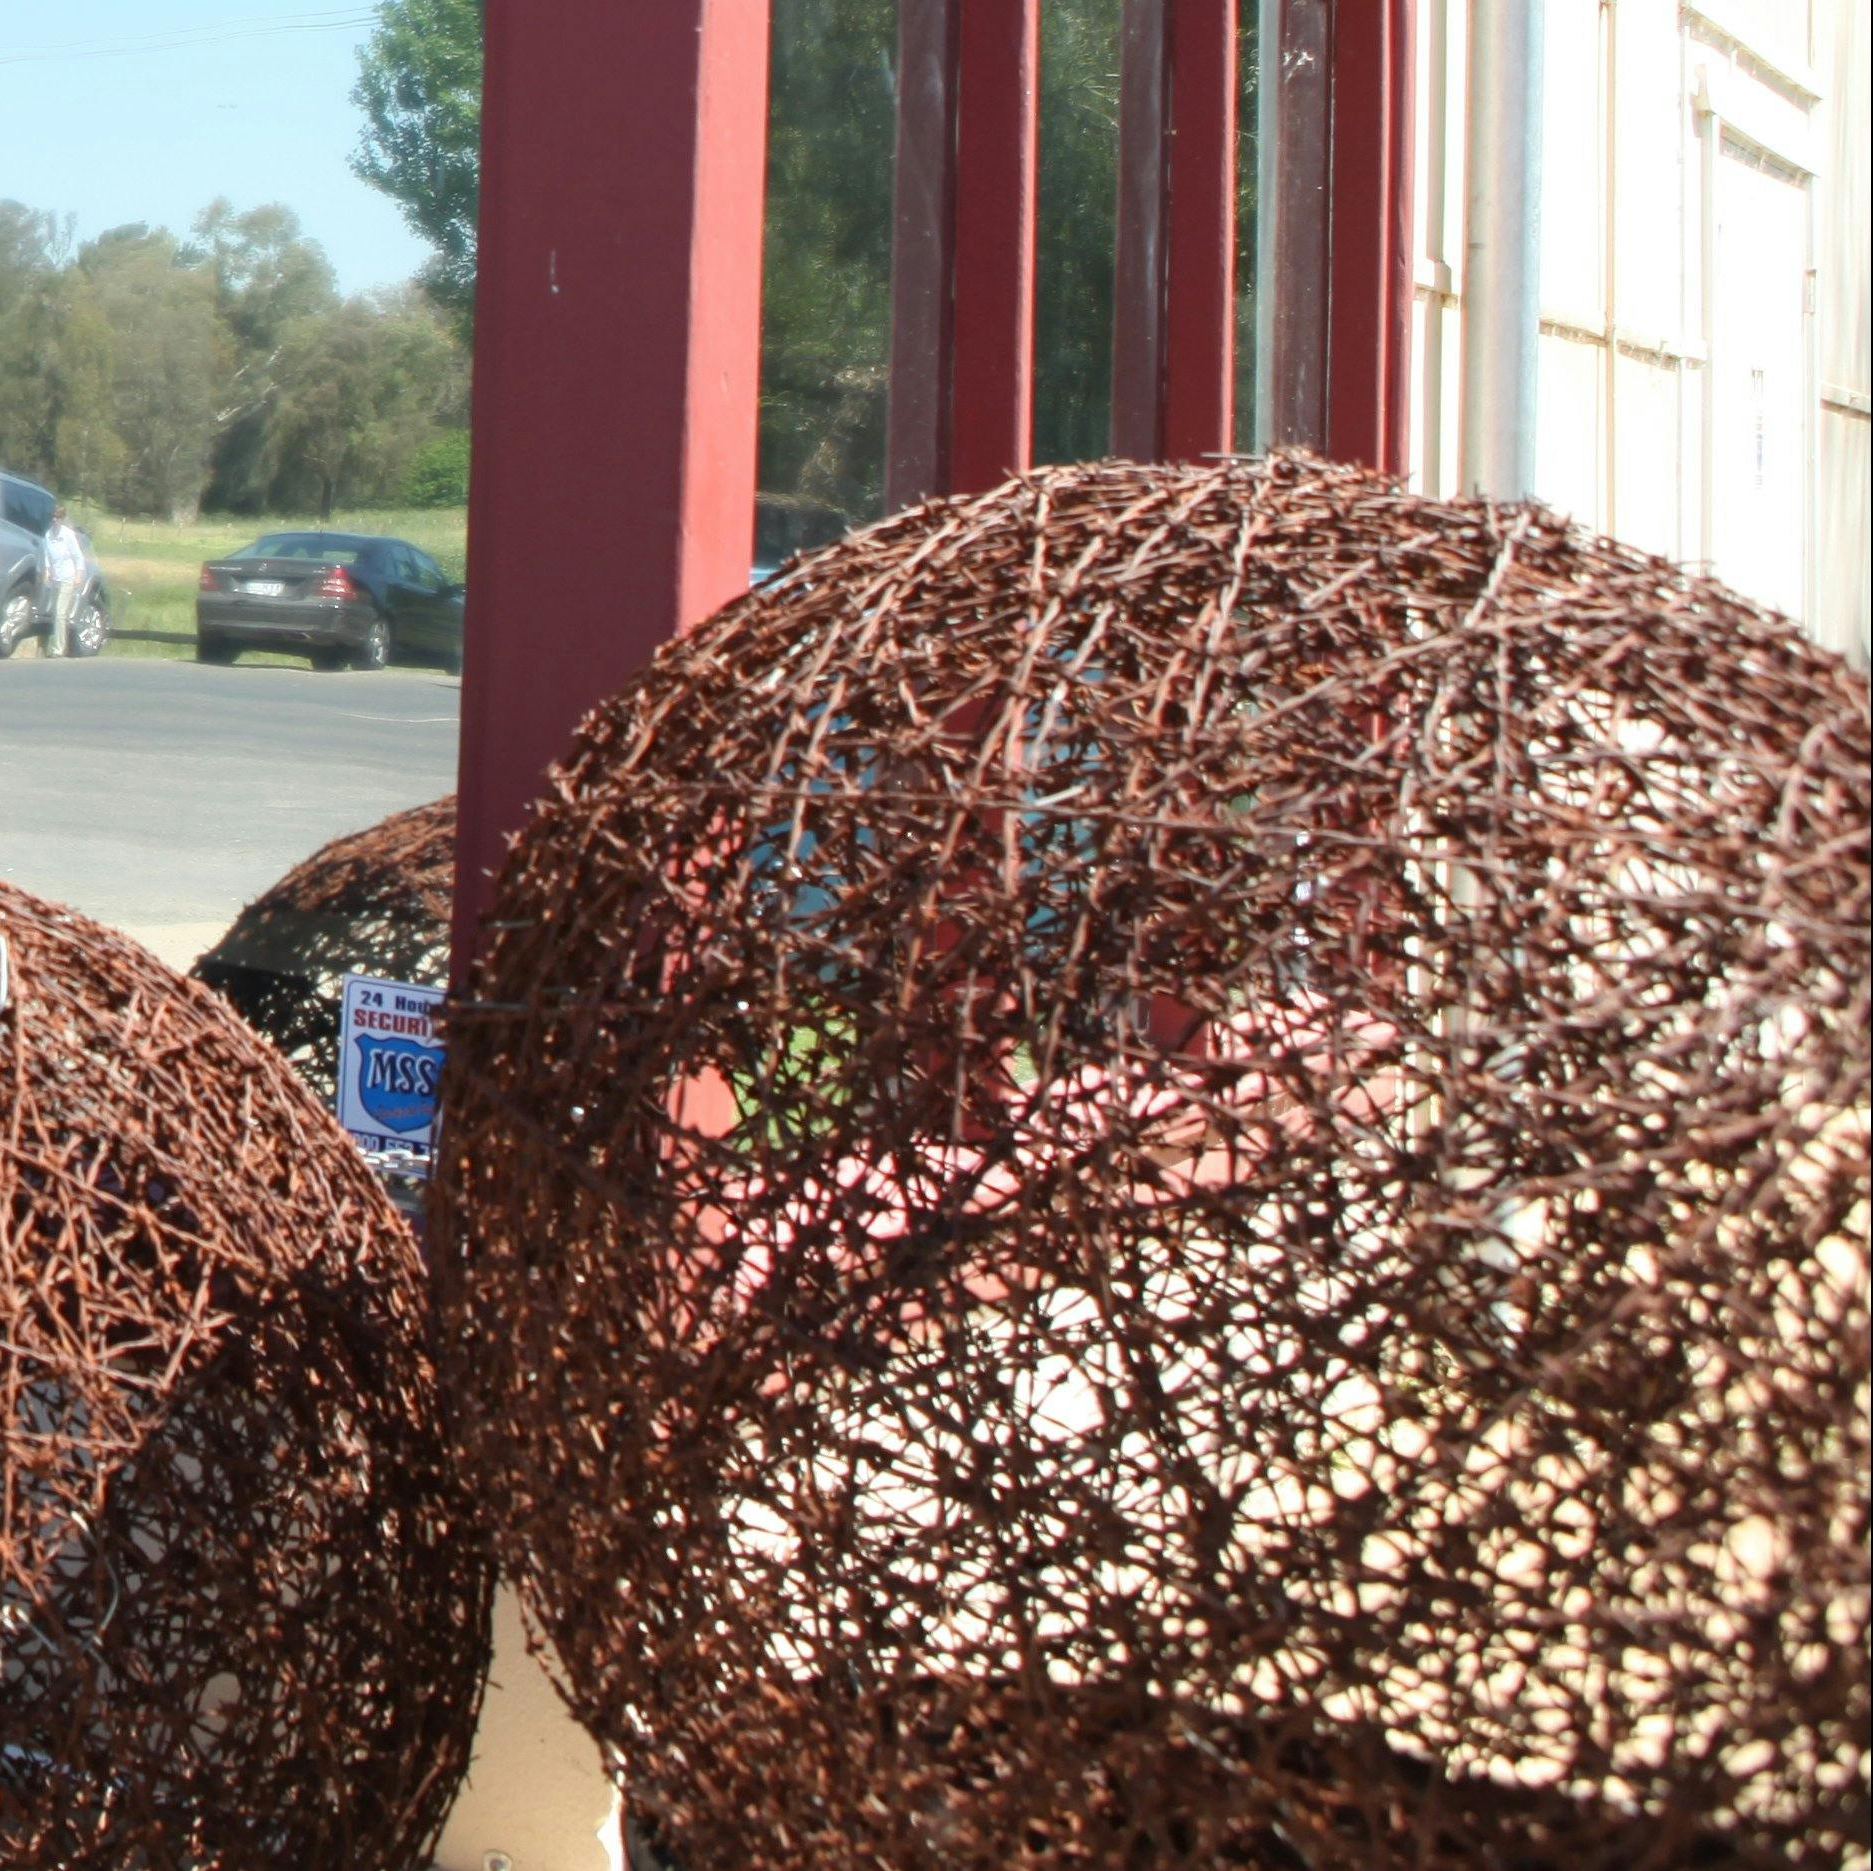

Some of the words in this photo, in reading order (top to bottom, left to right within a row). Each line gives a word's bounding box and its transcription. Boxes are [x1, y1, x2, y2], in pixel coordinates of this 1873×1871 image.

[360, 990, 383, 1007] 24
[395, 996, 433, 1014] Hou
[367, 1048, 438, 1096] MSS
